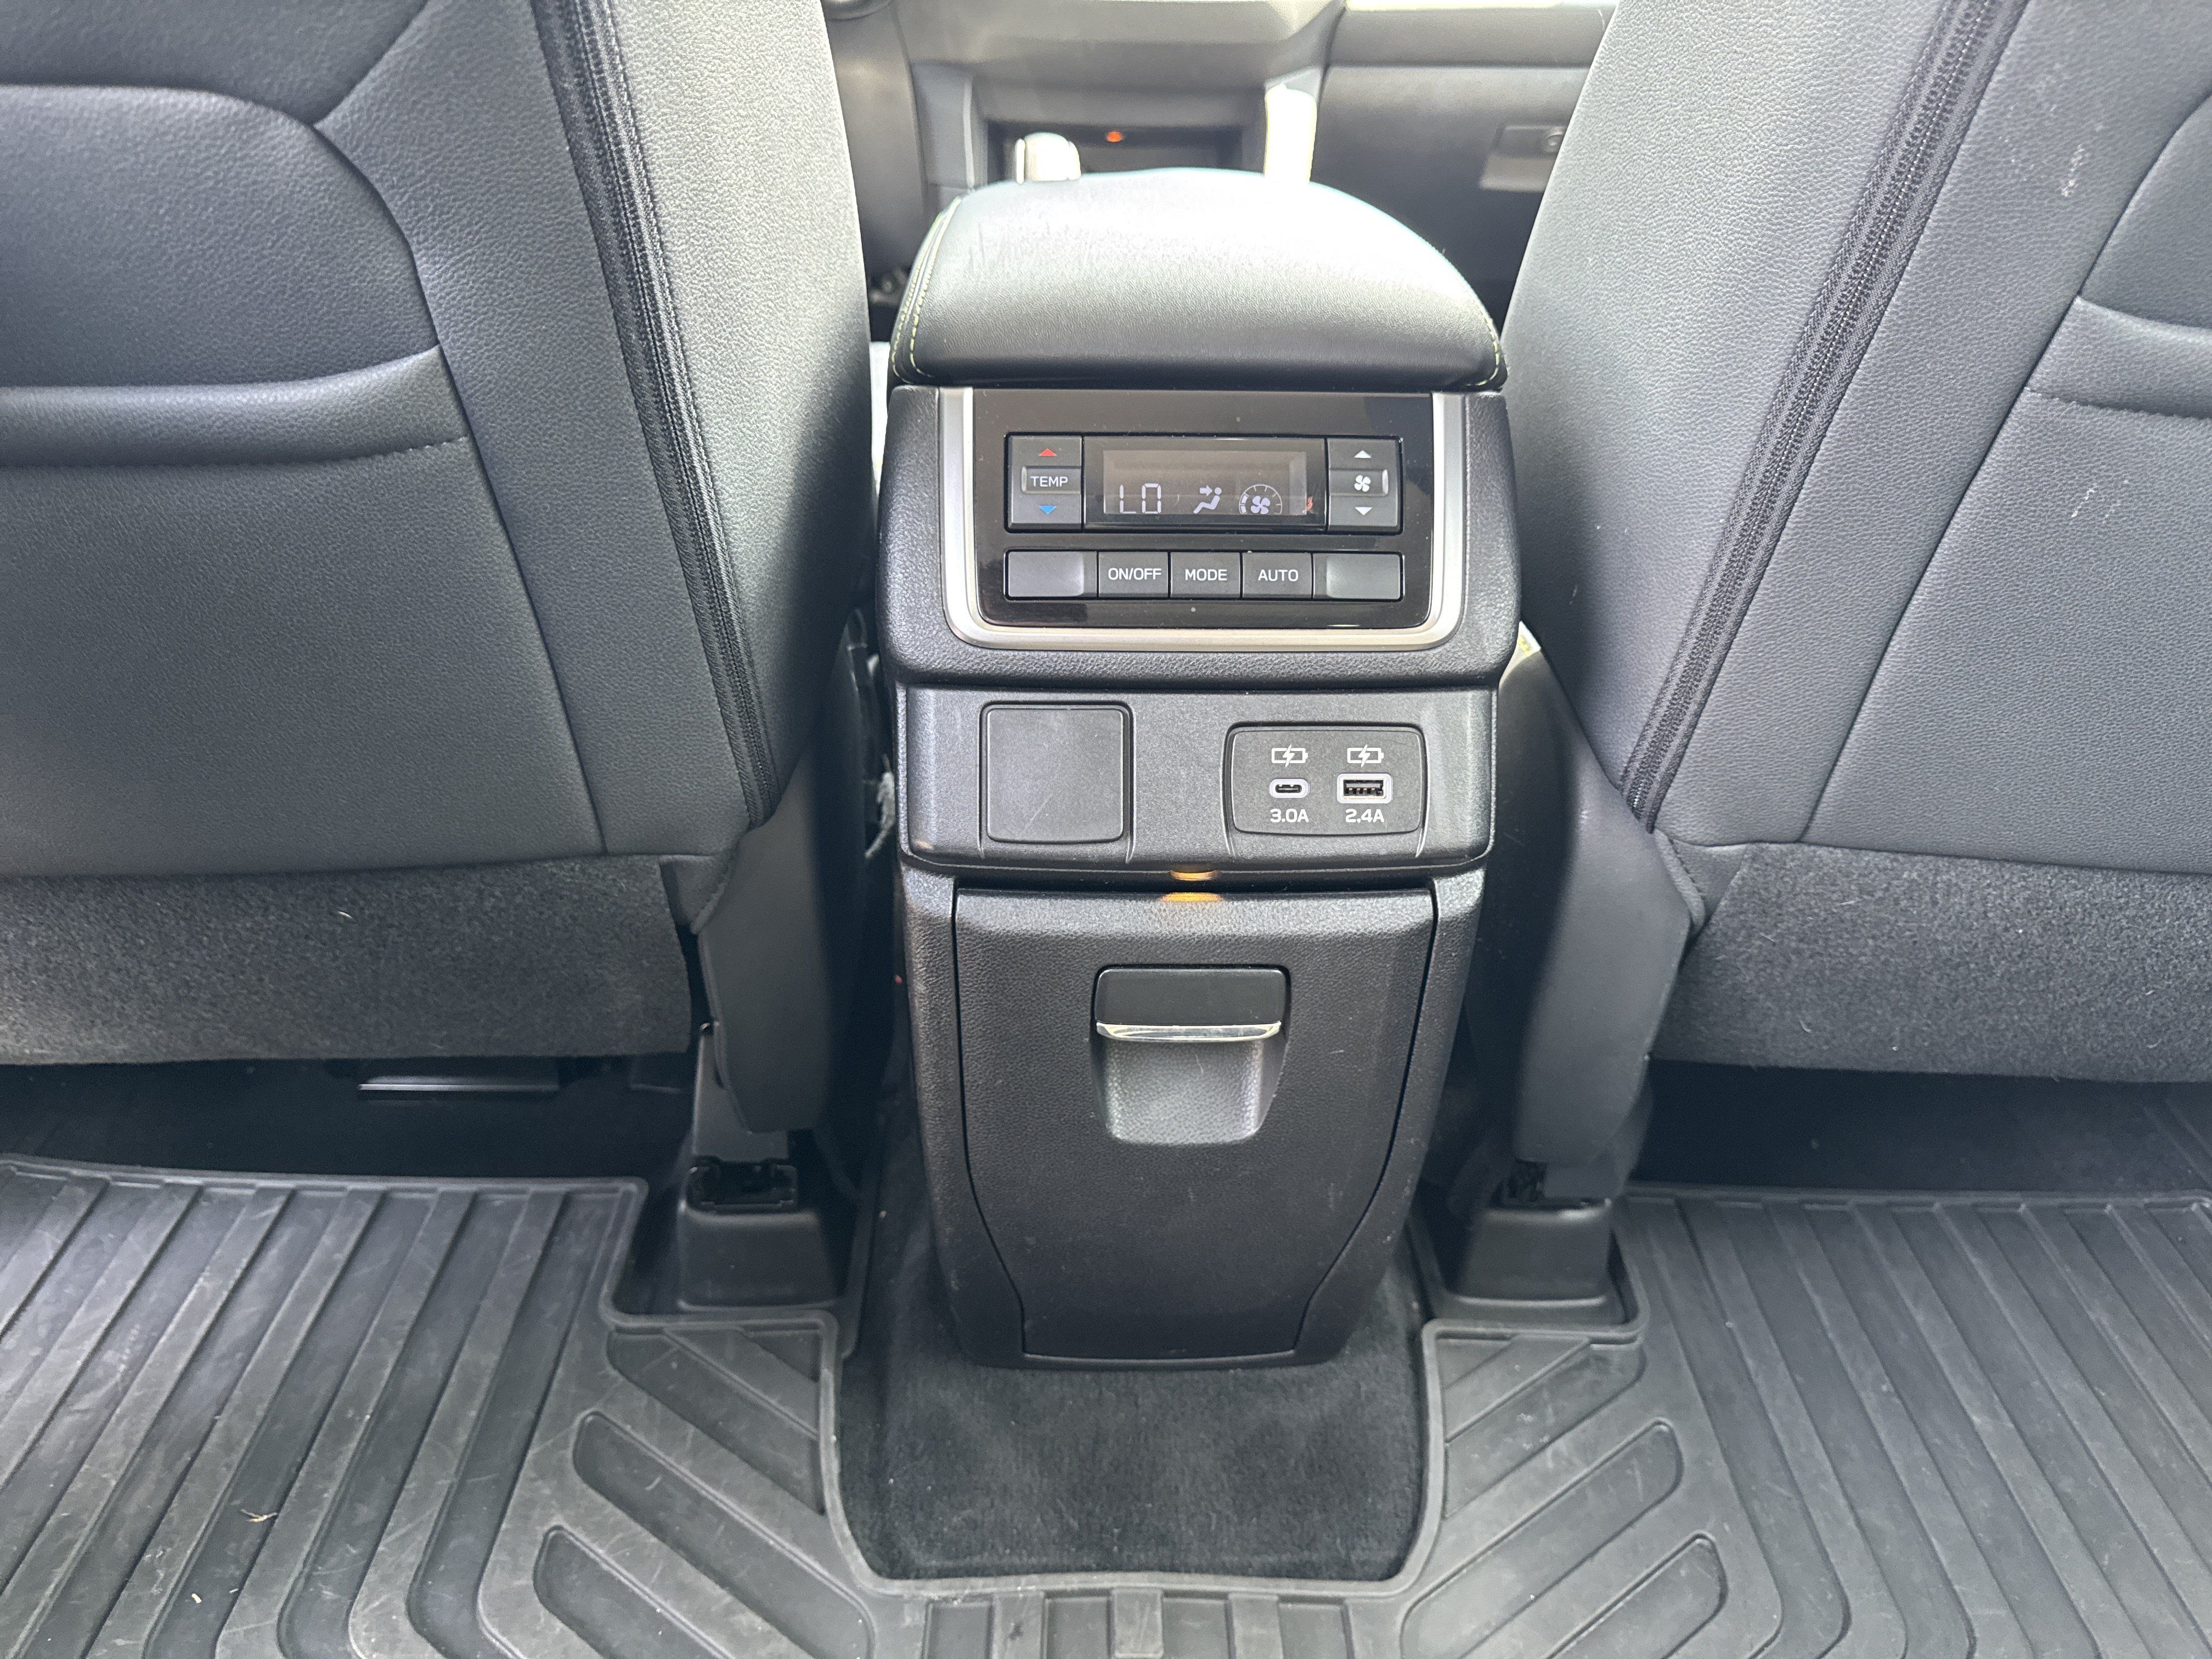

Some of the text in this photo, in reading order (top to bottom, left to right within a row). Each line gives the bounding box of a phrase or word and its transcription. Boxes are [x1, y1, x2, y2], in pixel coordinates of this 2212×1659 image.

[1030, 475, 1068, 488] TEMP
[1108, 568, 1162, 581] ON/OFF
[1184, 569, 1227, 582] MODE
[1257, 569, 1299, 582] AUTO
[1269, 809, 1309, 823] 3.0A
[1345, 809, 1385, 823] 2.4A
